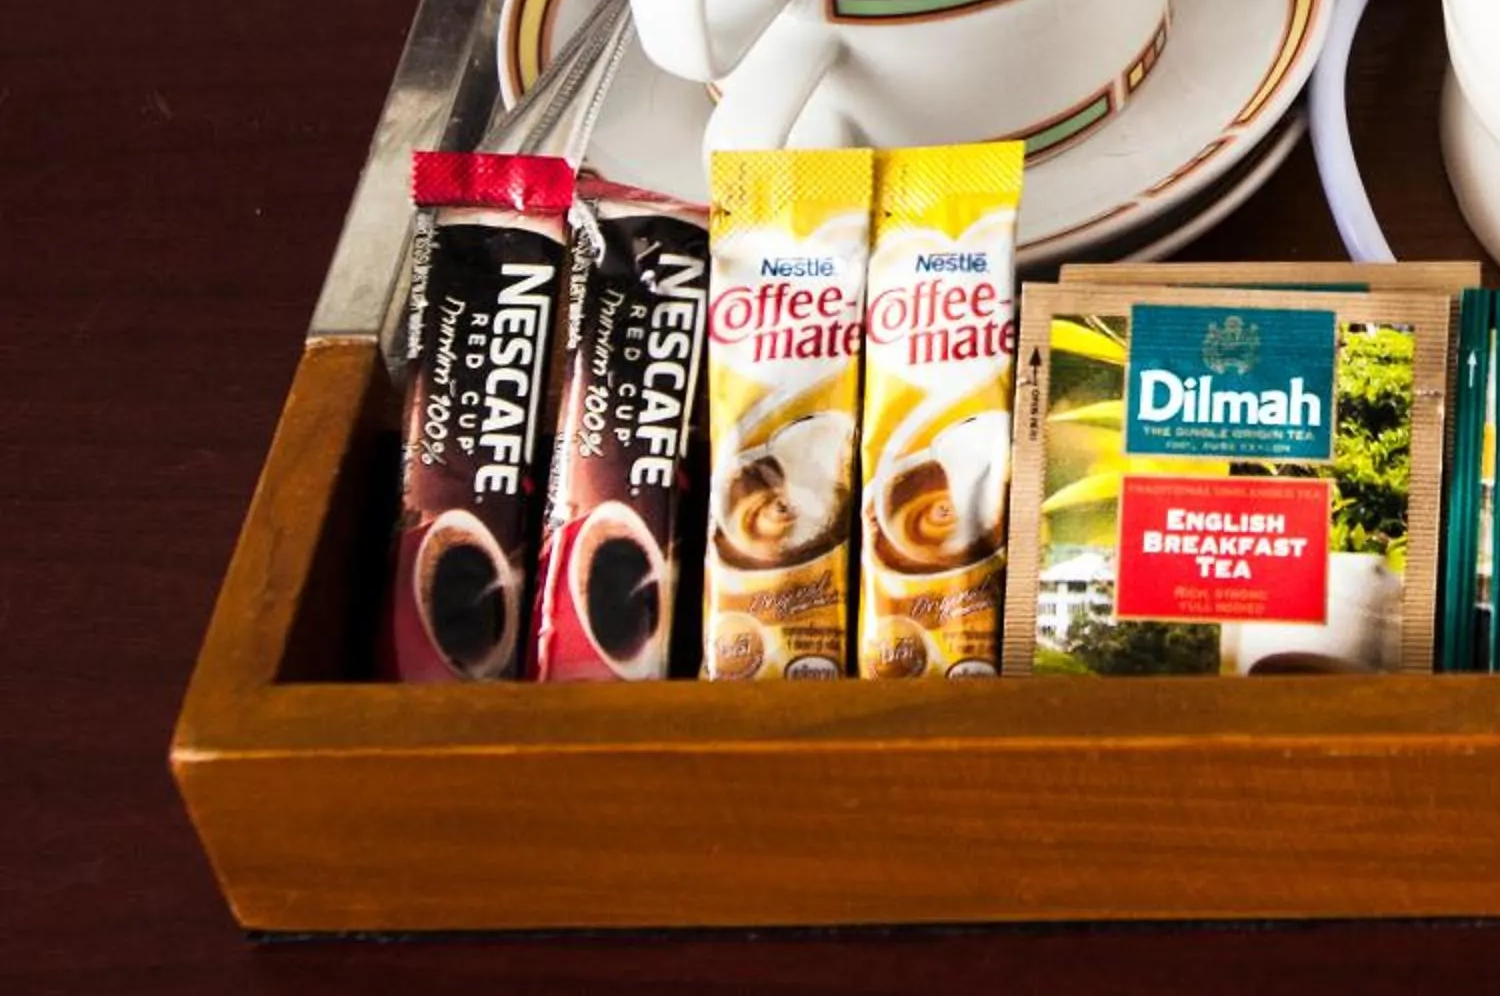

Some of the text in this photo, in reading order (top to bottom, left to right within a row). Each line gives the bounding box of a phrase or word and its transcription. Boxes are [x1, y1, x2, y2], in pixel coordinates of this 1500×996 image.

[754, 320, 863, 363] mate
[908, 318, 1015, 365] mate
[456, 312, 489, 451] RED CUP
[613, 305, 647, 443] RED CUP
[1138, 368, 1321, 427] Dilmah
[421, 393, 452, 465] 100%
[579, 385, 609, 458] 100%
[1143, 530, 1308, 557] BREAKFAST
[1166, 507, 1285, 534] ENGLISH
[1195, 555, 1252, 579] TEA
